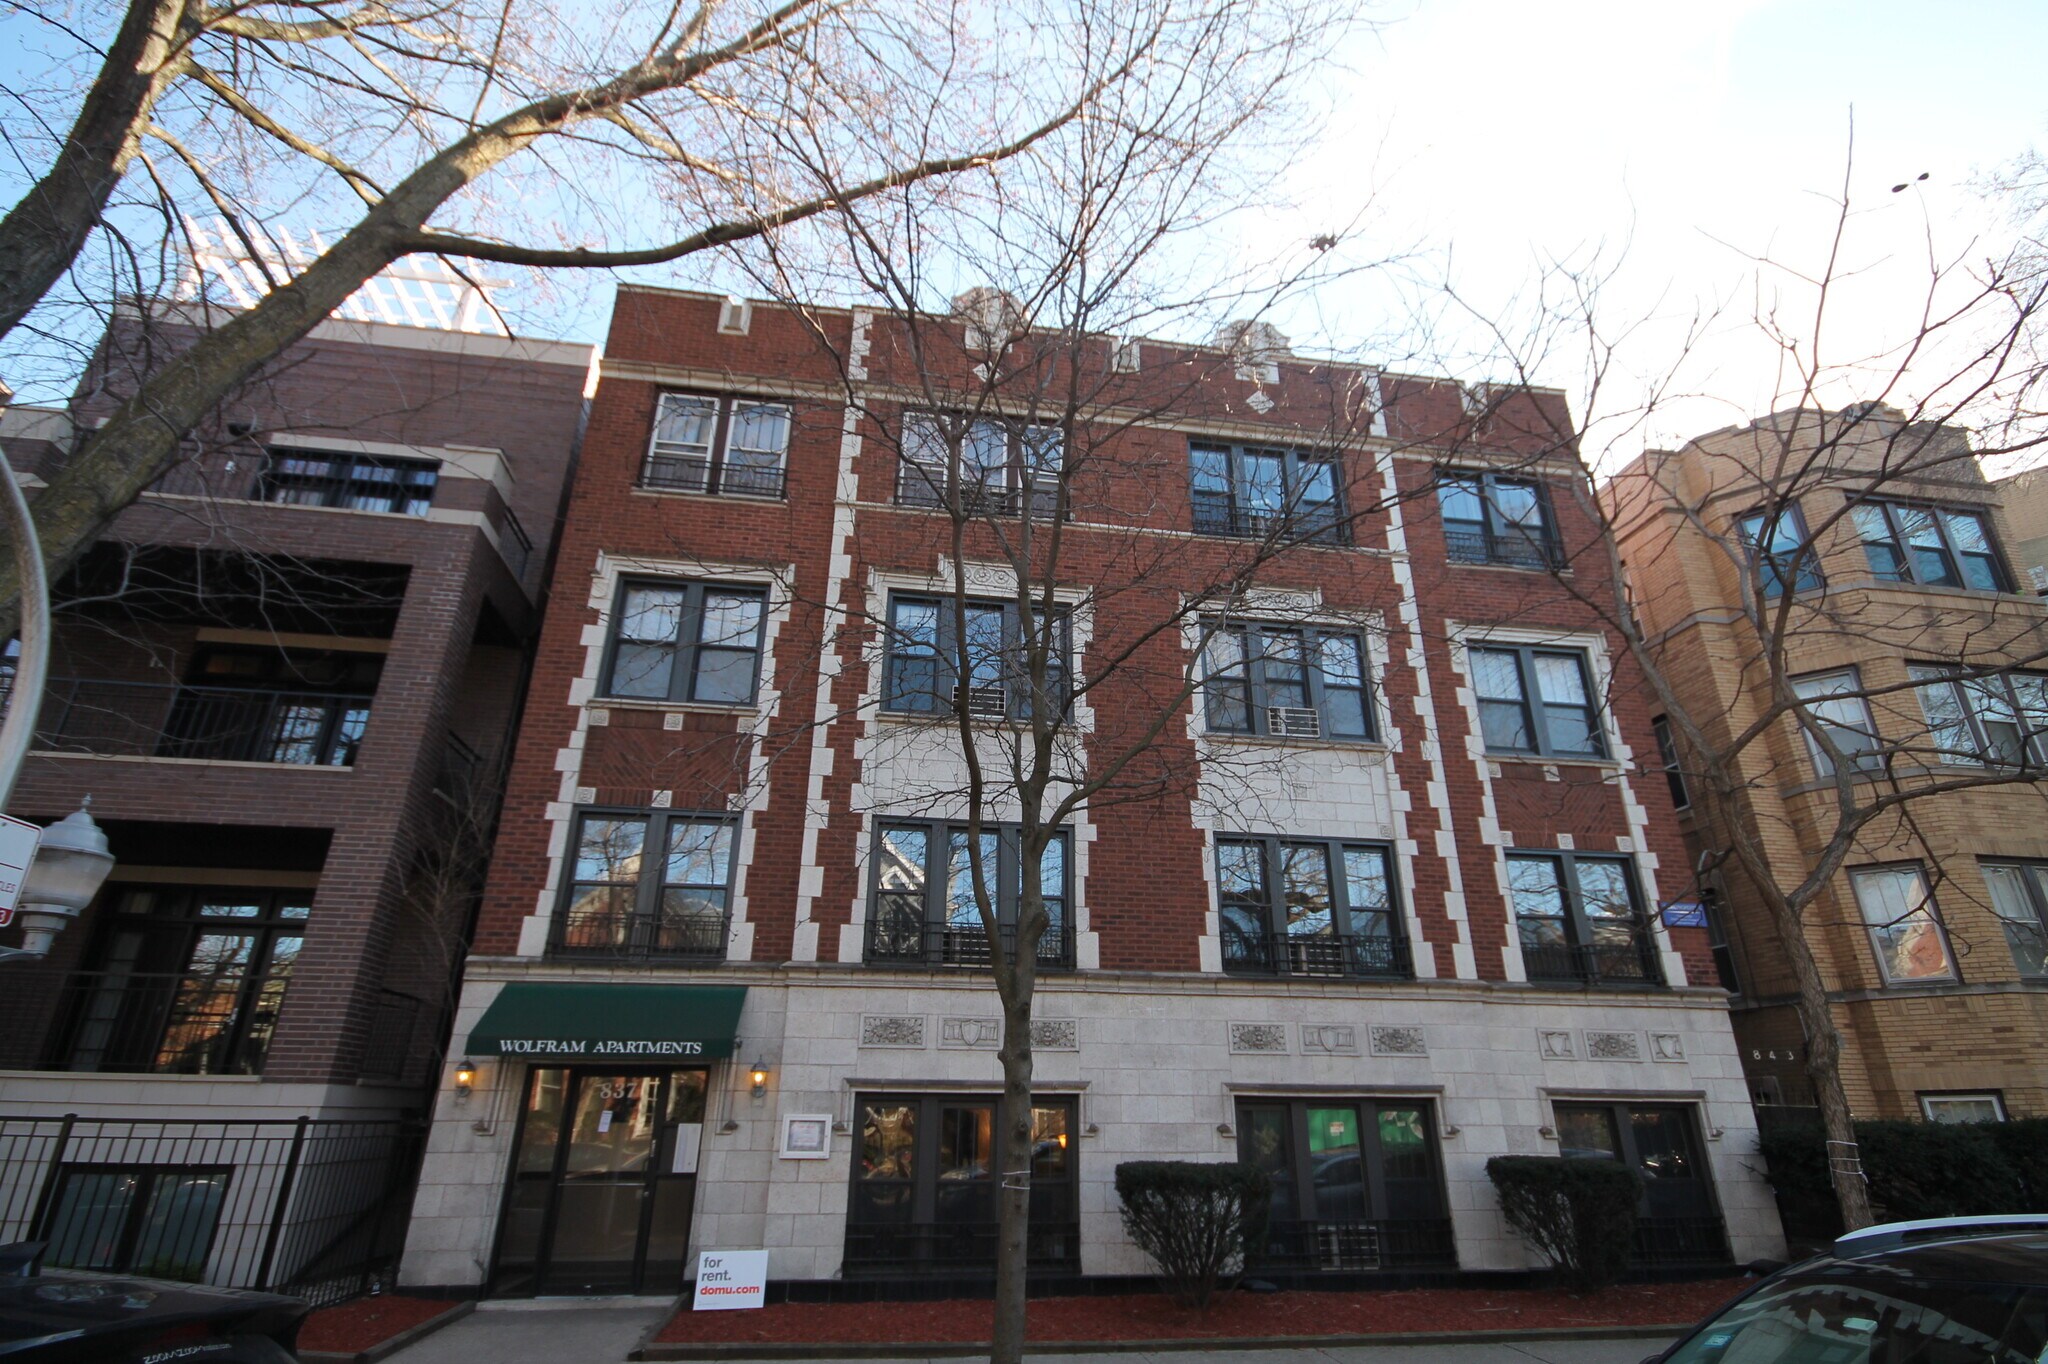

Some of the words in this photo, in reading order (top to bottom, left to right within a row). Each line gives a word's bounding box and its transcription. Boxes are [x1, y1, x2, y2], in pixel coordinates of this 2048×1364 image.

[500, 1040, 587, 1053] WOLFRAM
[593, 1041, 702, 1054] APARTMENTS
[600, 1082, 637, 1099] 837
[704, 1256, 723, 1268] for
[701, 1270, 732, 1281] rent.
[700, 1286, 760, 1295] domu.com
